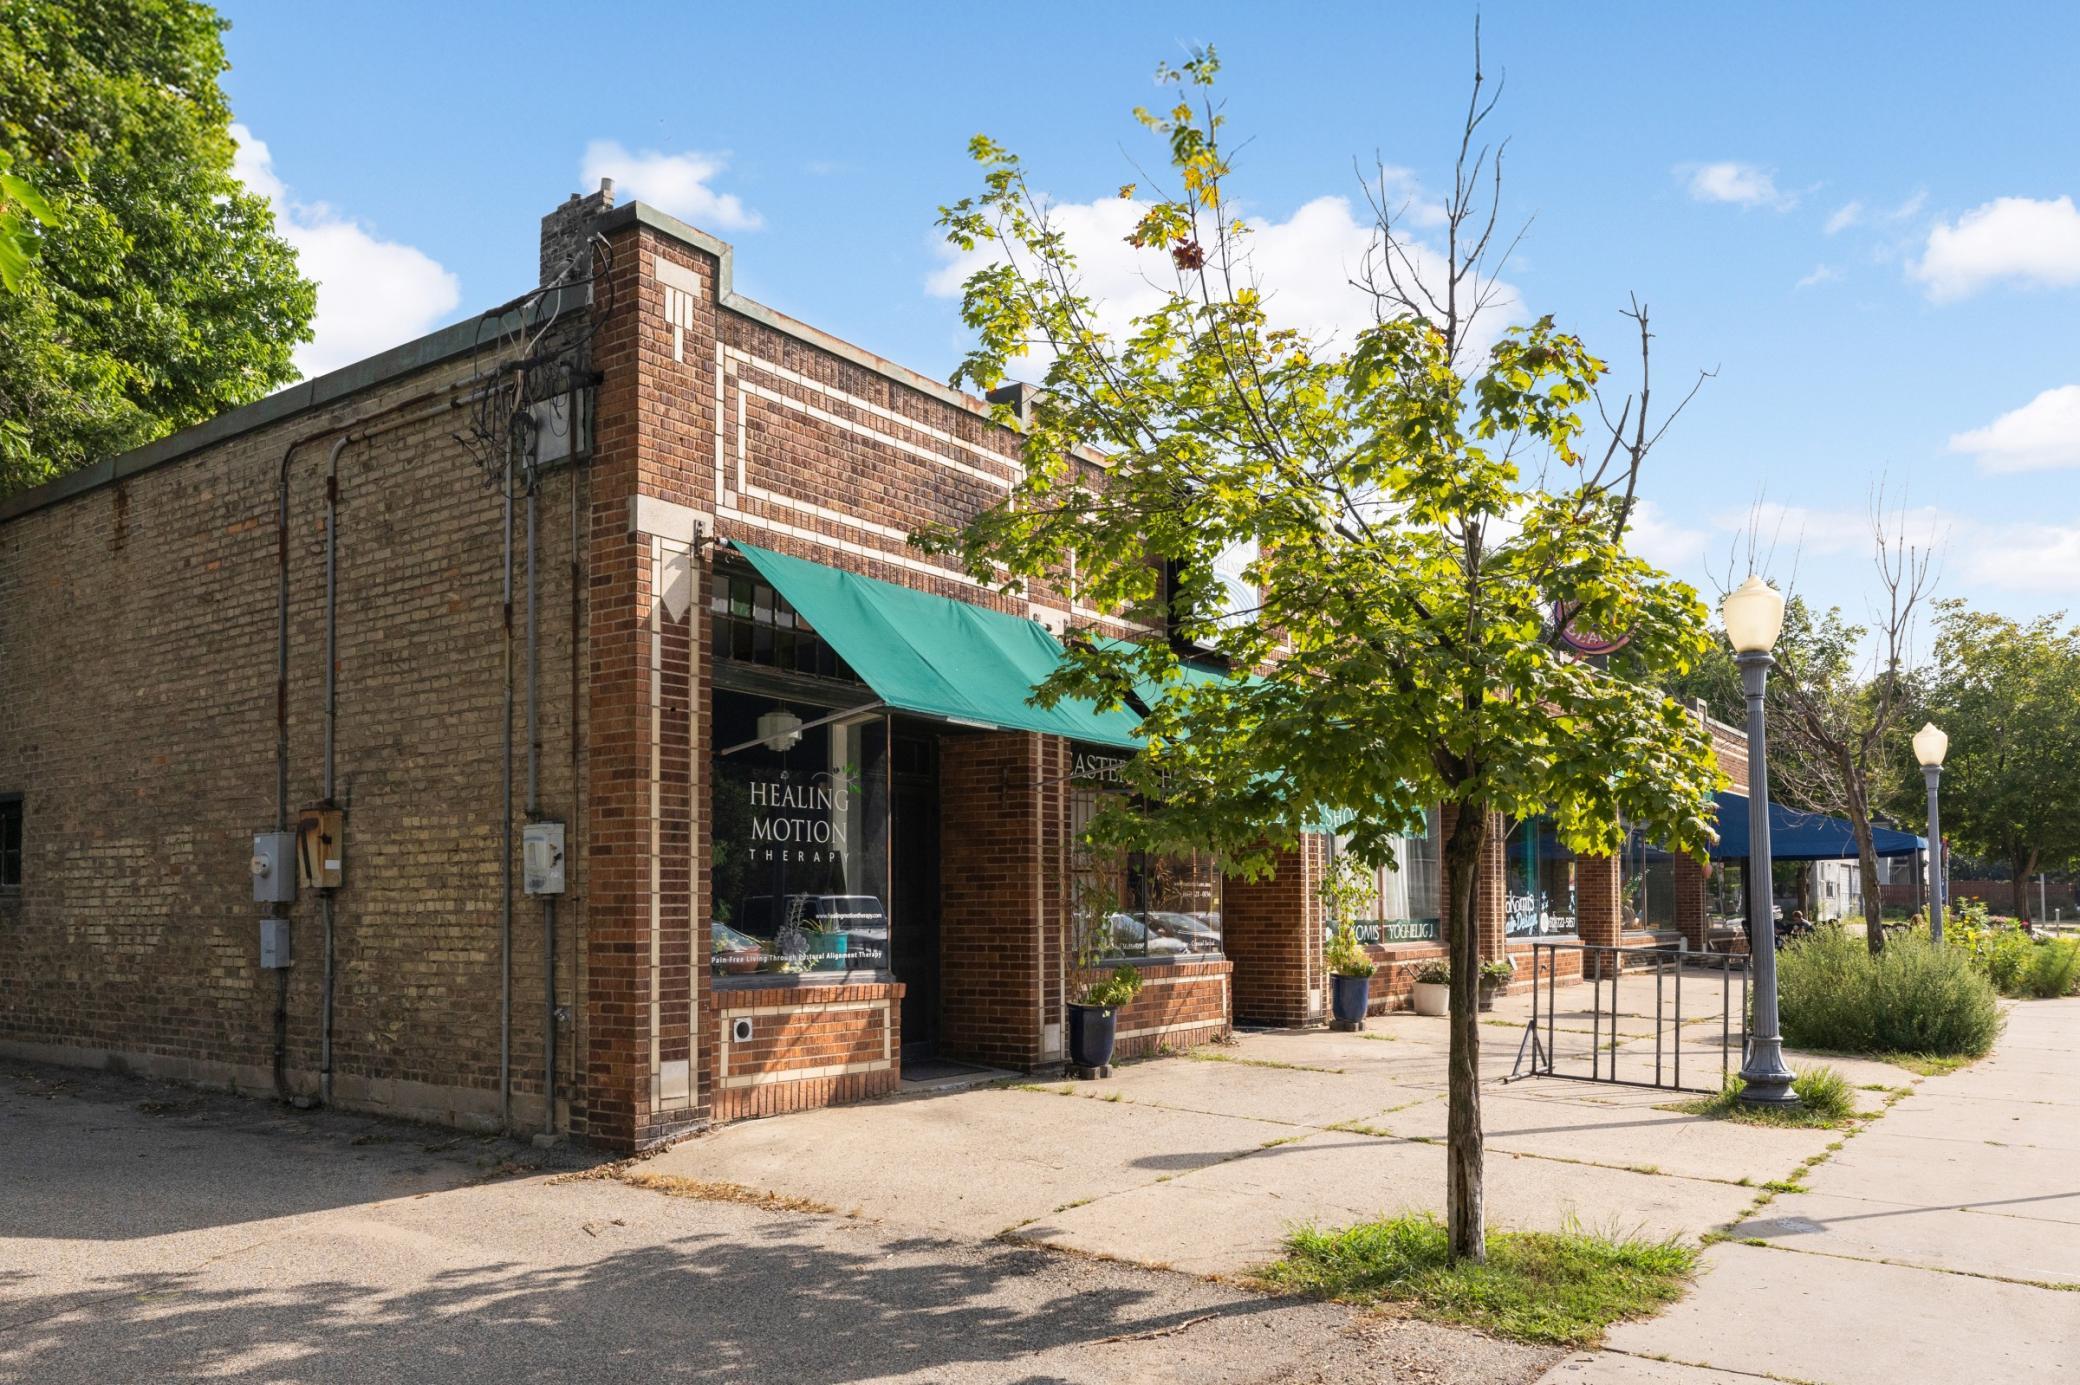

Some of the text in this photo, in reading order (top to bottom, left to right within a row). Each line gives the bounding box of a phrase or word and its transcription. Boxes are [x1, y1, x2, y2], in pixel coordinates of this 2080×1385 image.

[749, 781, 849, 812] HEALING
[751, 816, 847, 844] MOTION
[749, 848, 849, 863] THERAPY
[746, 955, 768, 963] Living
[826, 951, 858, 960] Alignment
[858, 950, 882, 959] Therapy
